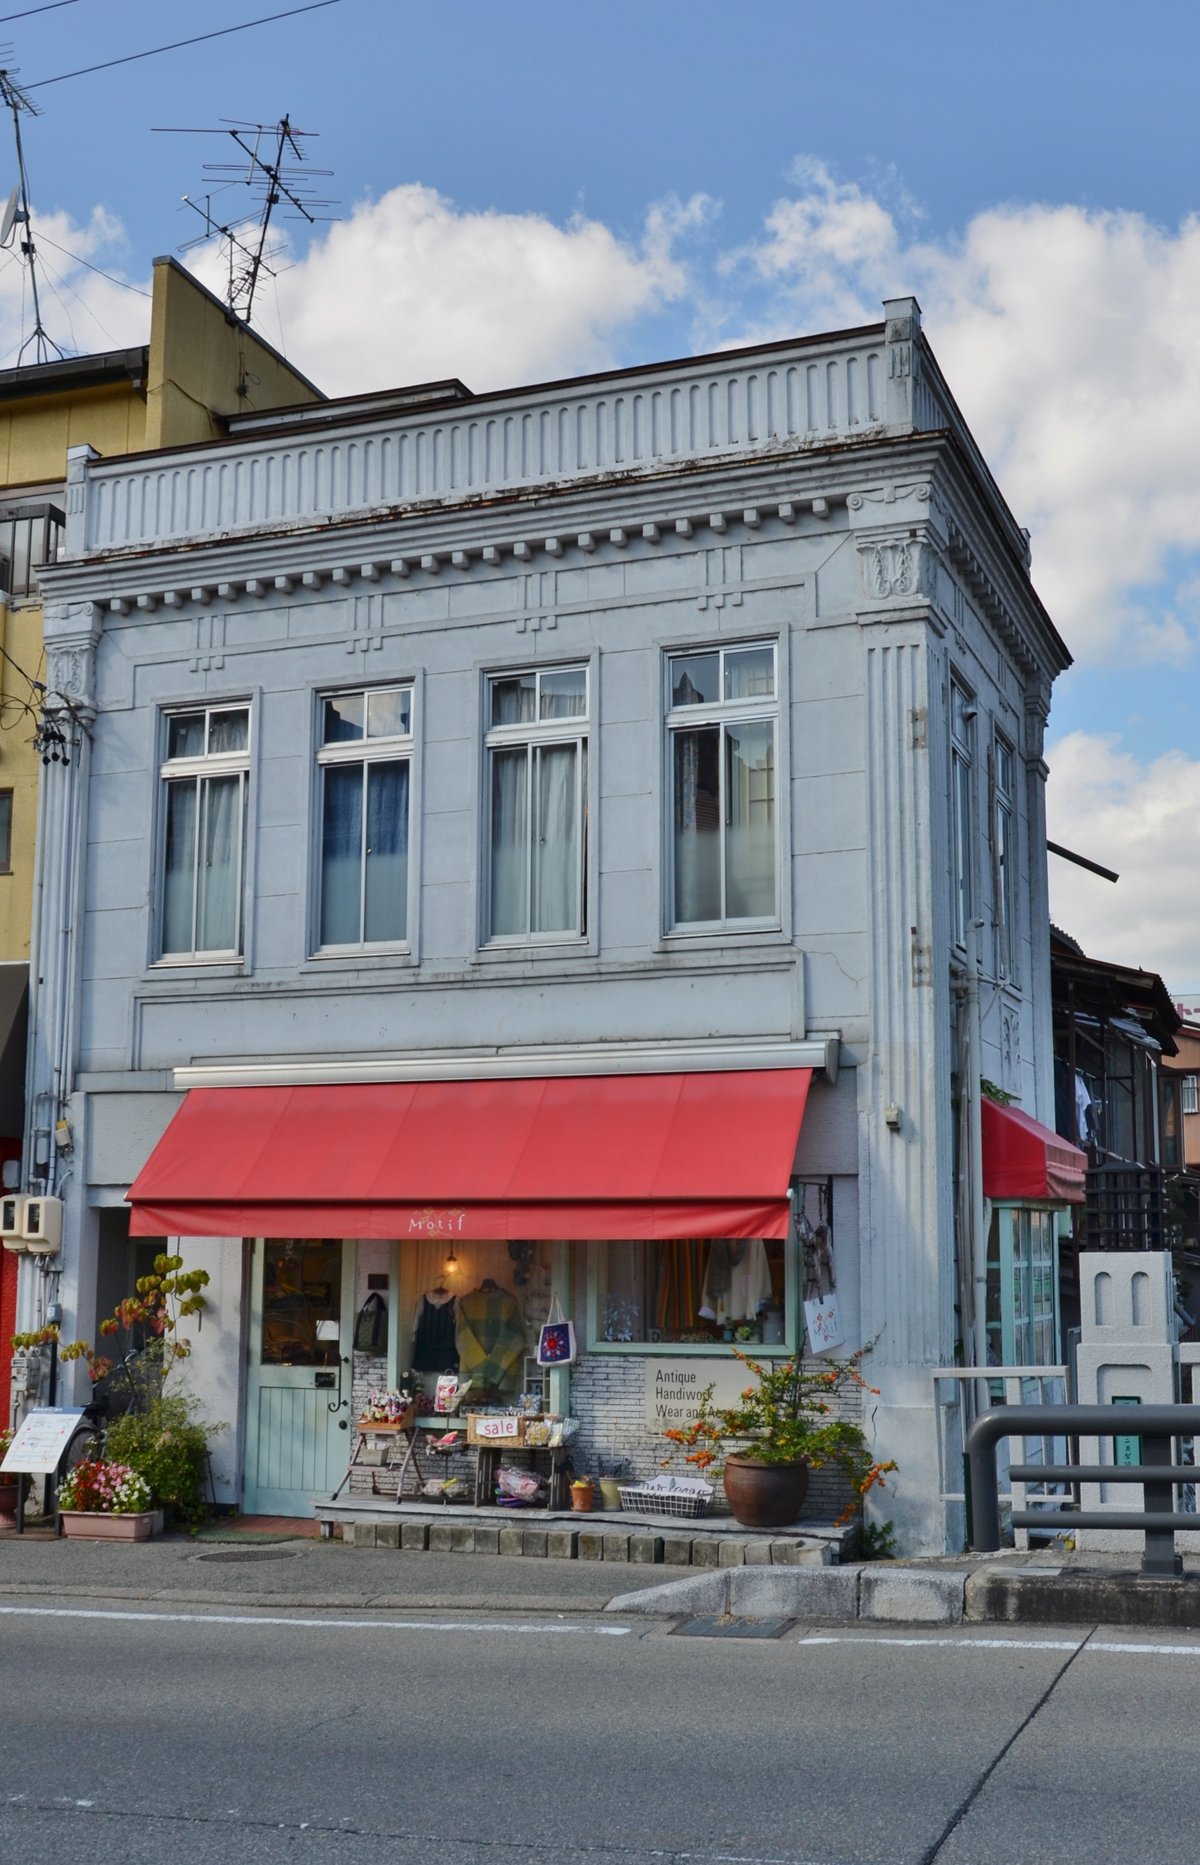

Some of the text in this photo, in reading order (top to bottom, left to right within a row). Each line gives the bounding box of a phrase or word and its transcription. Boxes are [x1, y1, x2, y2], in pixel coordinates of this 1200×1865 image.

[408, 1214, 466, 1233] Motif
[656, 1369, 697, 1386] Antique
[655, 1404, 684, 1419] Wear
[484, 1420, 514, 1436] sale
